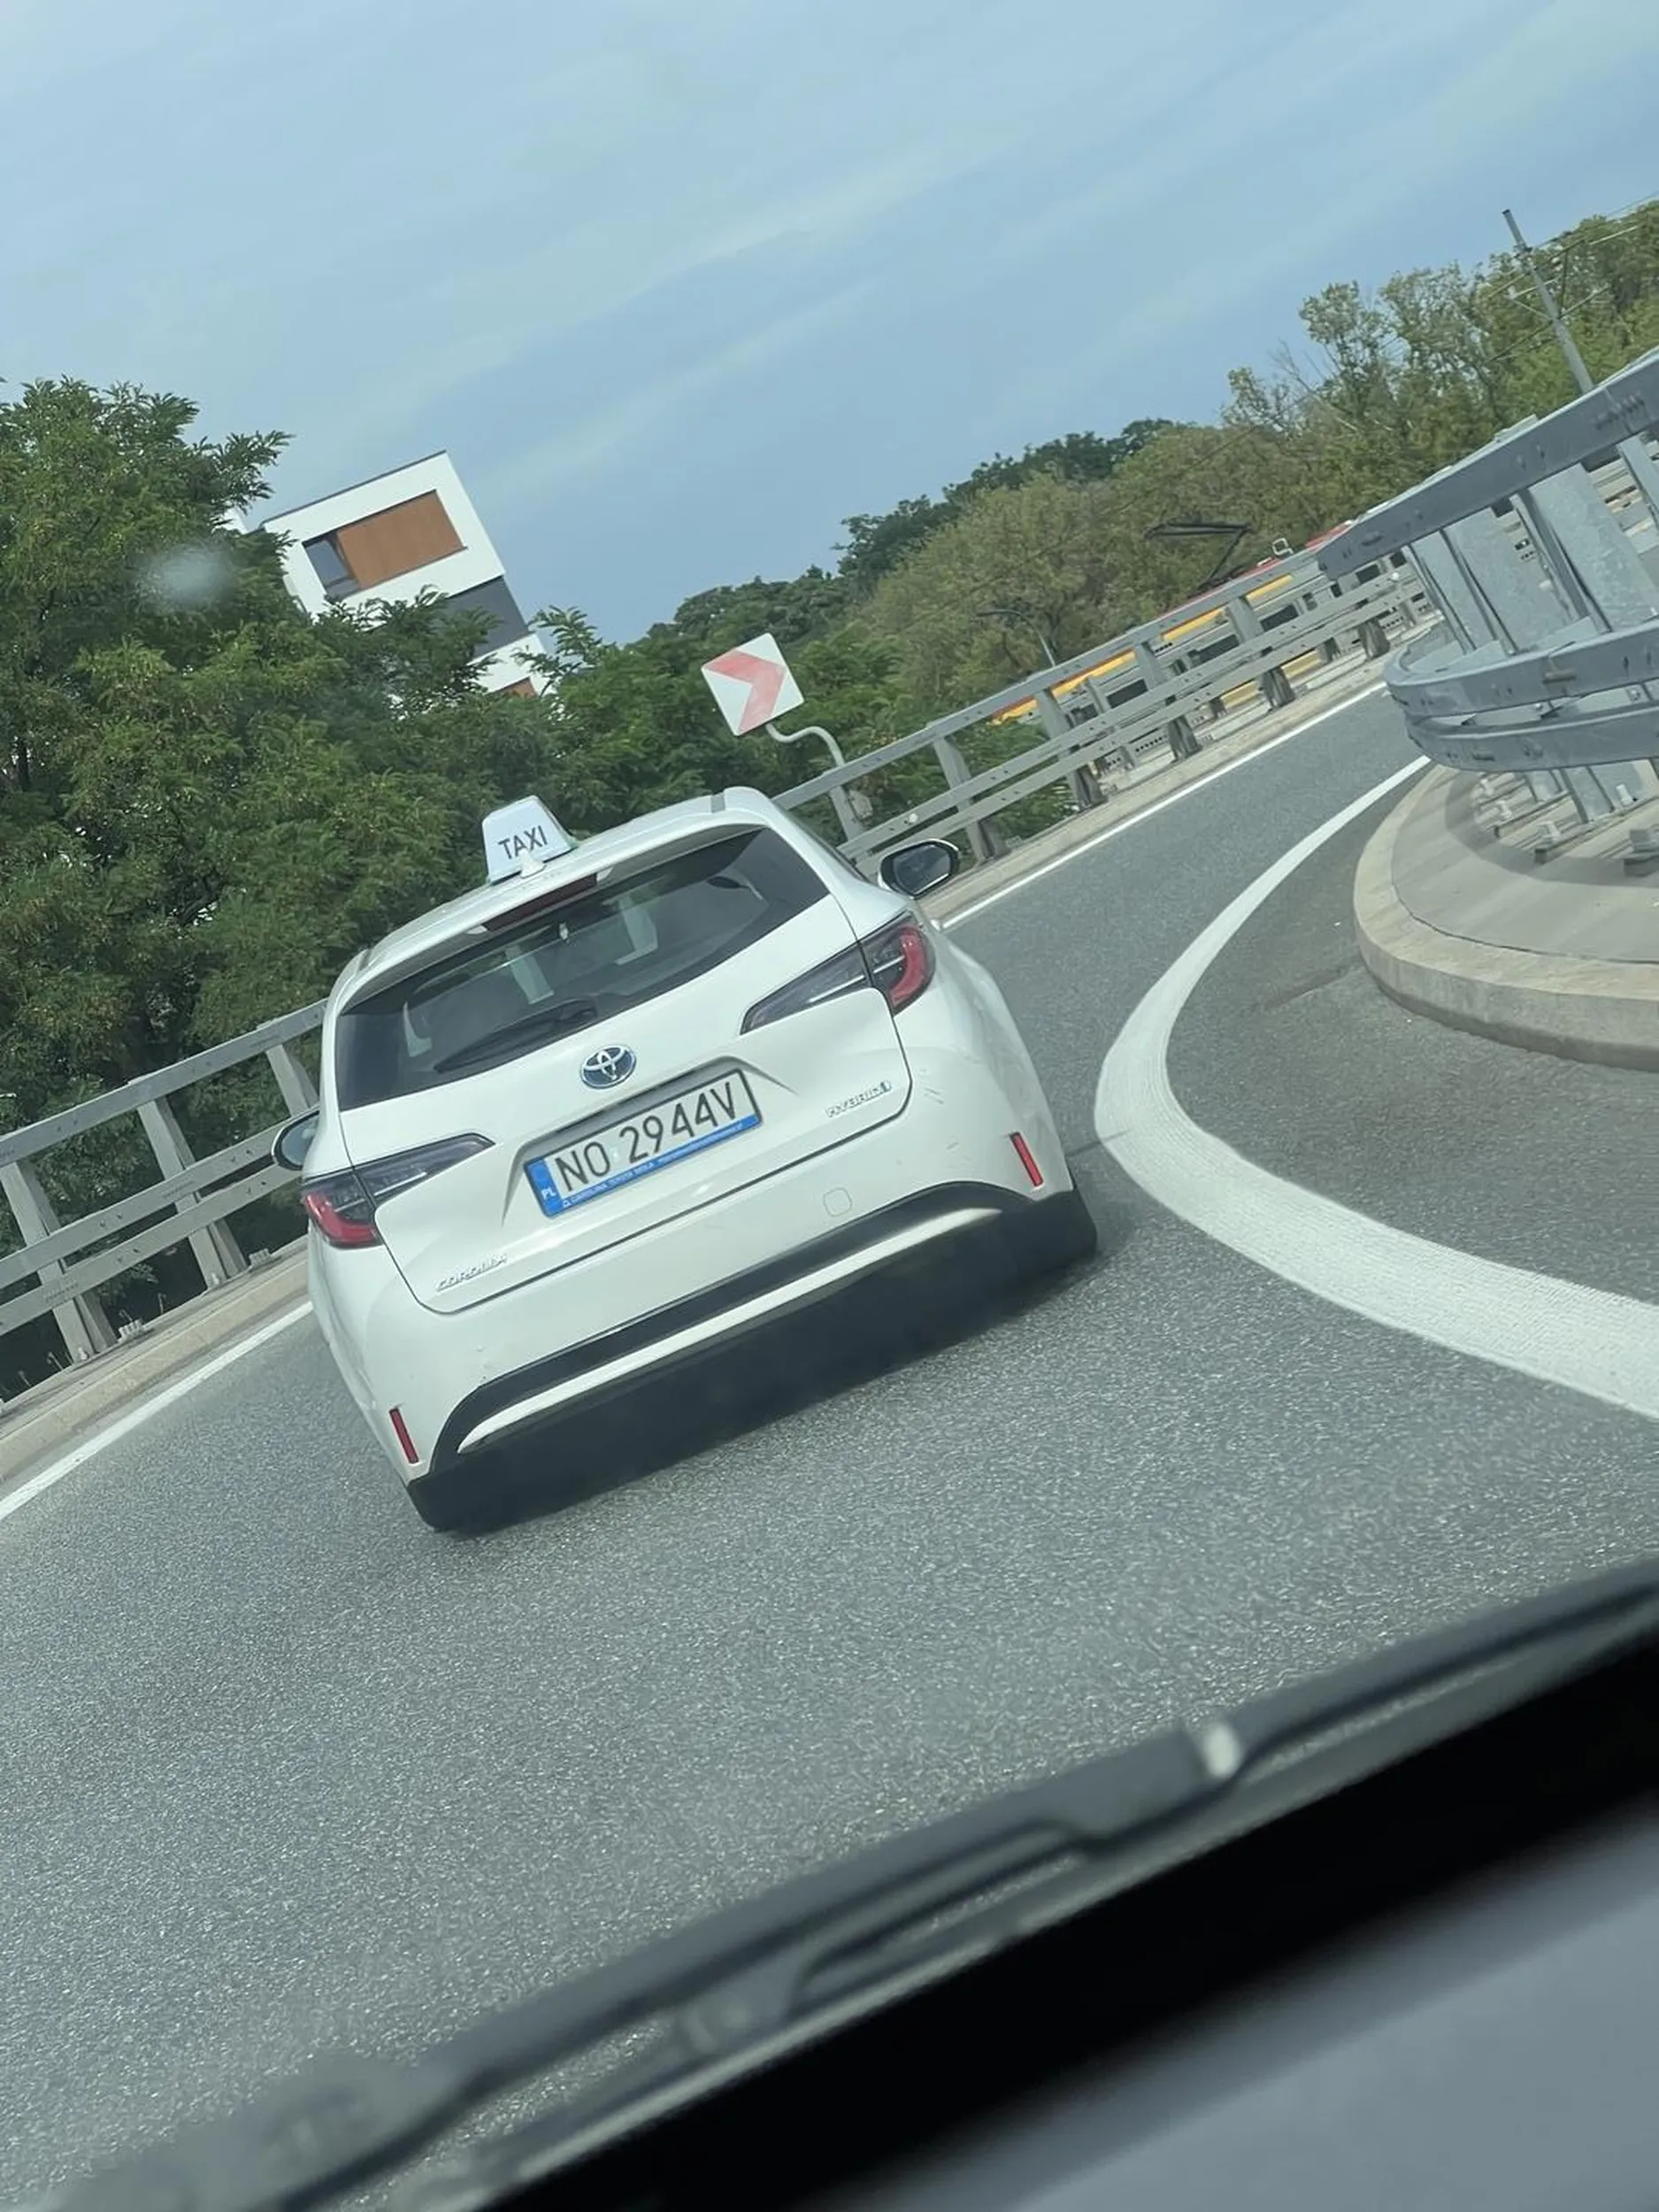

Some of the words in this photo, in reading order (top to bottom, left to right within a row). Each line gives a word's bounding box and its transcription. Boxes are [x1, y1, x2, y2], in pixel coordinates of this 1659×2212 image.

[498, 825, 548, 859] TAXI
[555, 1141, 611, 1192] NO
[619, 1081, 736, 1164] 2944V
[541, 1187, 557, 1200] PL
